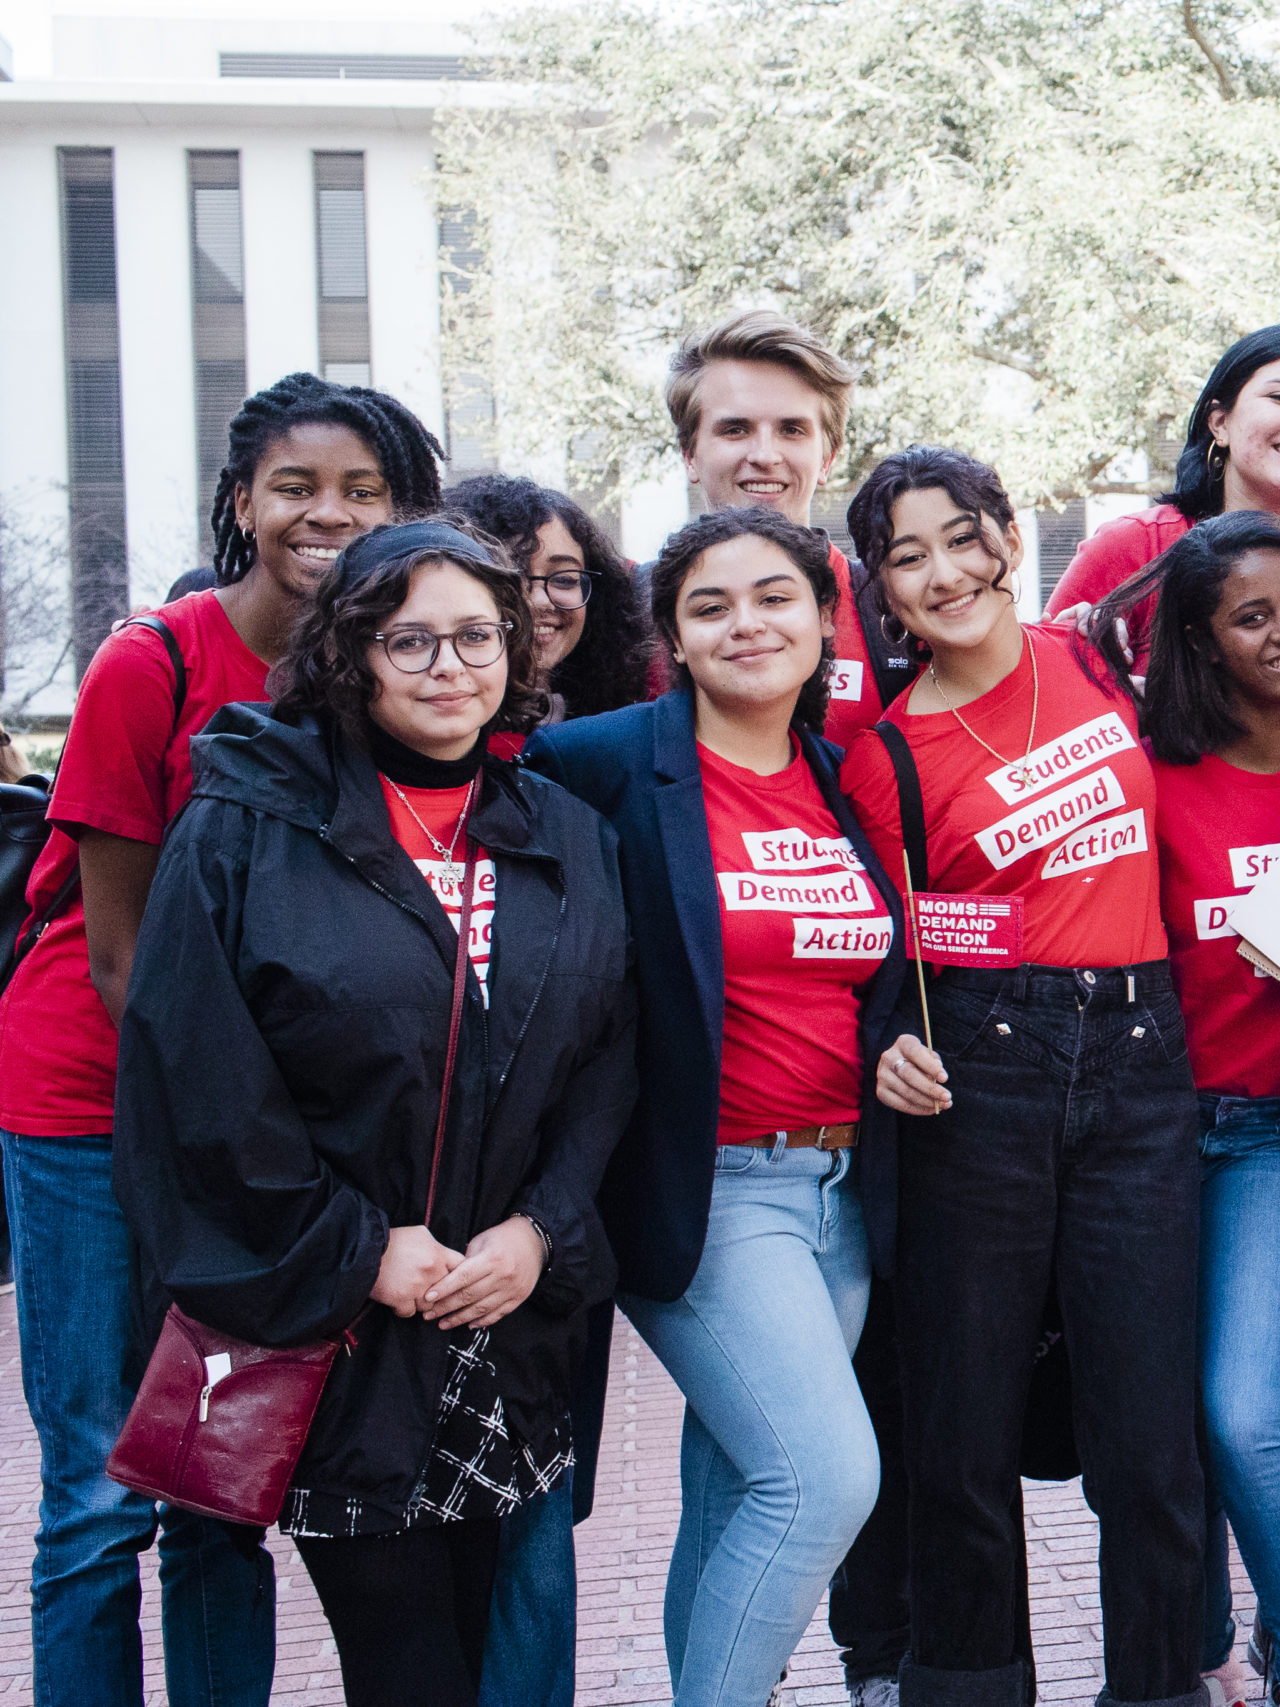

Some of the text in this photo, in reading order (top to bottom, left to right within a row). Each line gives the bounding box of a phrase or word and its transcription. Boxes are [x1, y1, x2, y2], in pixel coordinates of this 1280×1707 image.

[1006, 725, 1123, 792] Students
[994, 777, 1109, 857] Demand
[1050, 824, 1137, 868] Action
[738, 877, 859, 904] Demand
[918, 900, 978, 916] MOMS
[918, 915, 997, 931] DEMAND
[803, 926, 891, 951] Action
[921, 930, 988, 946] ACTION
